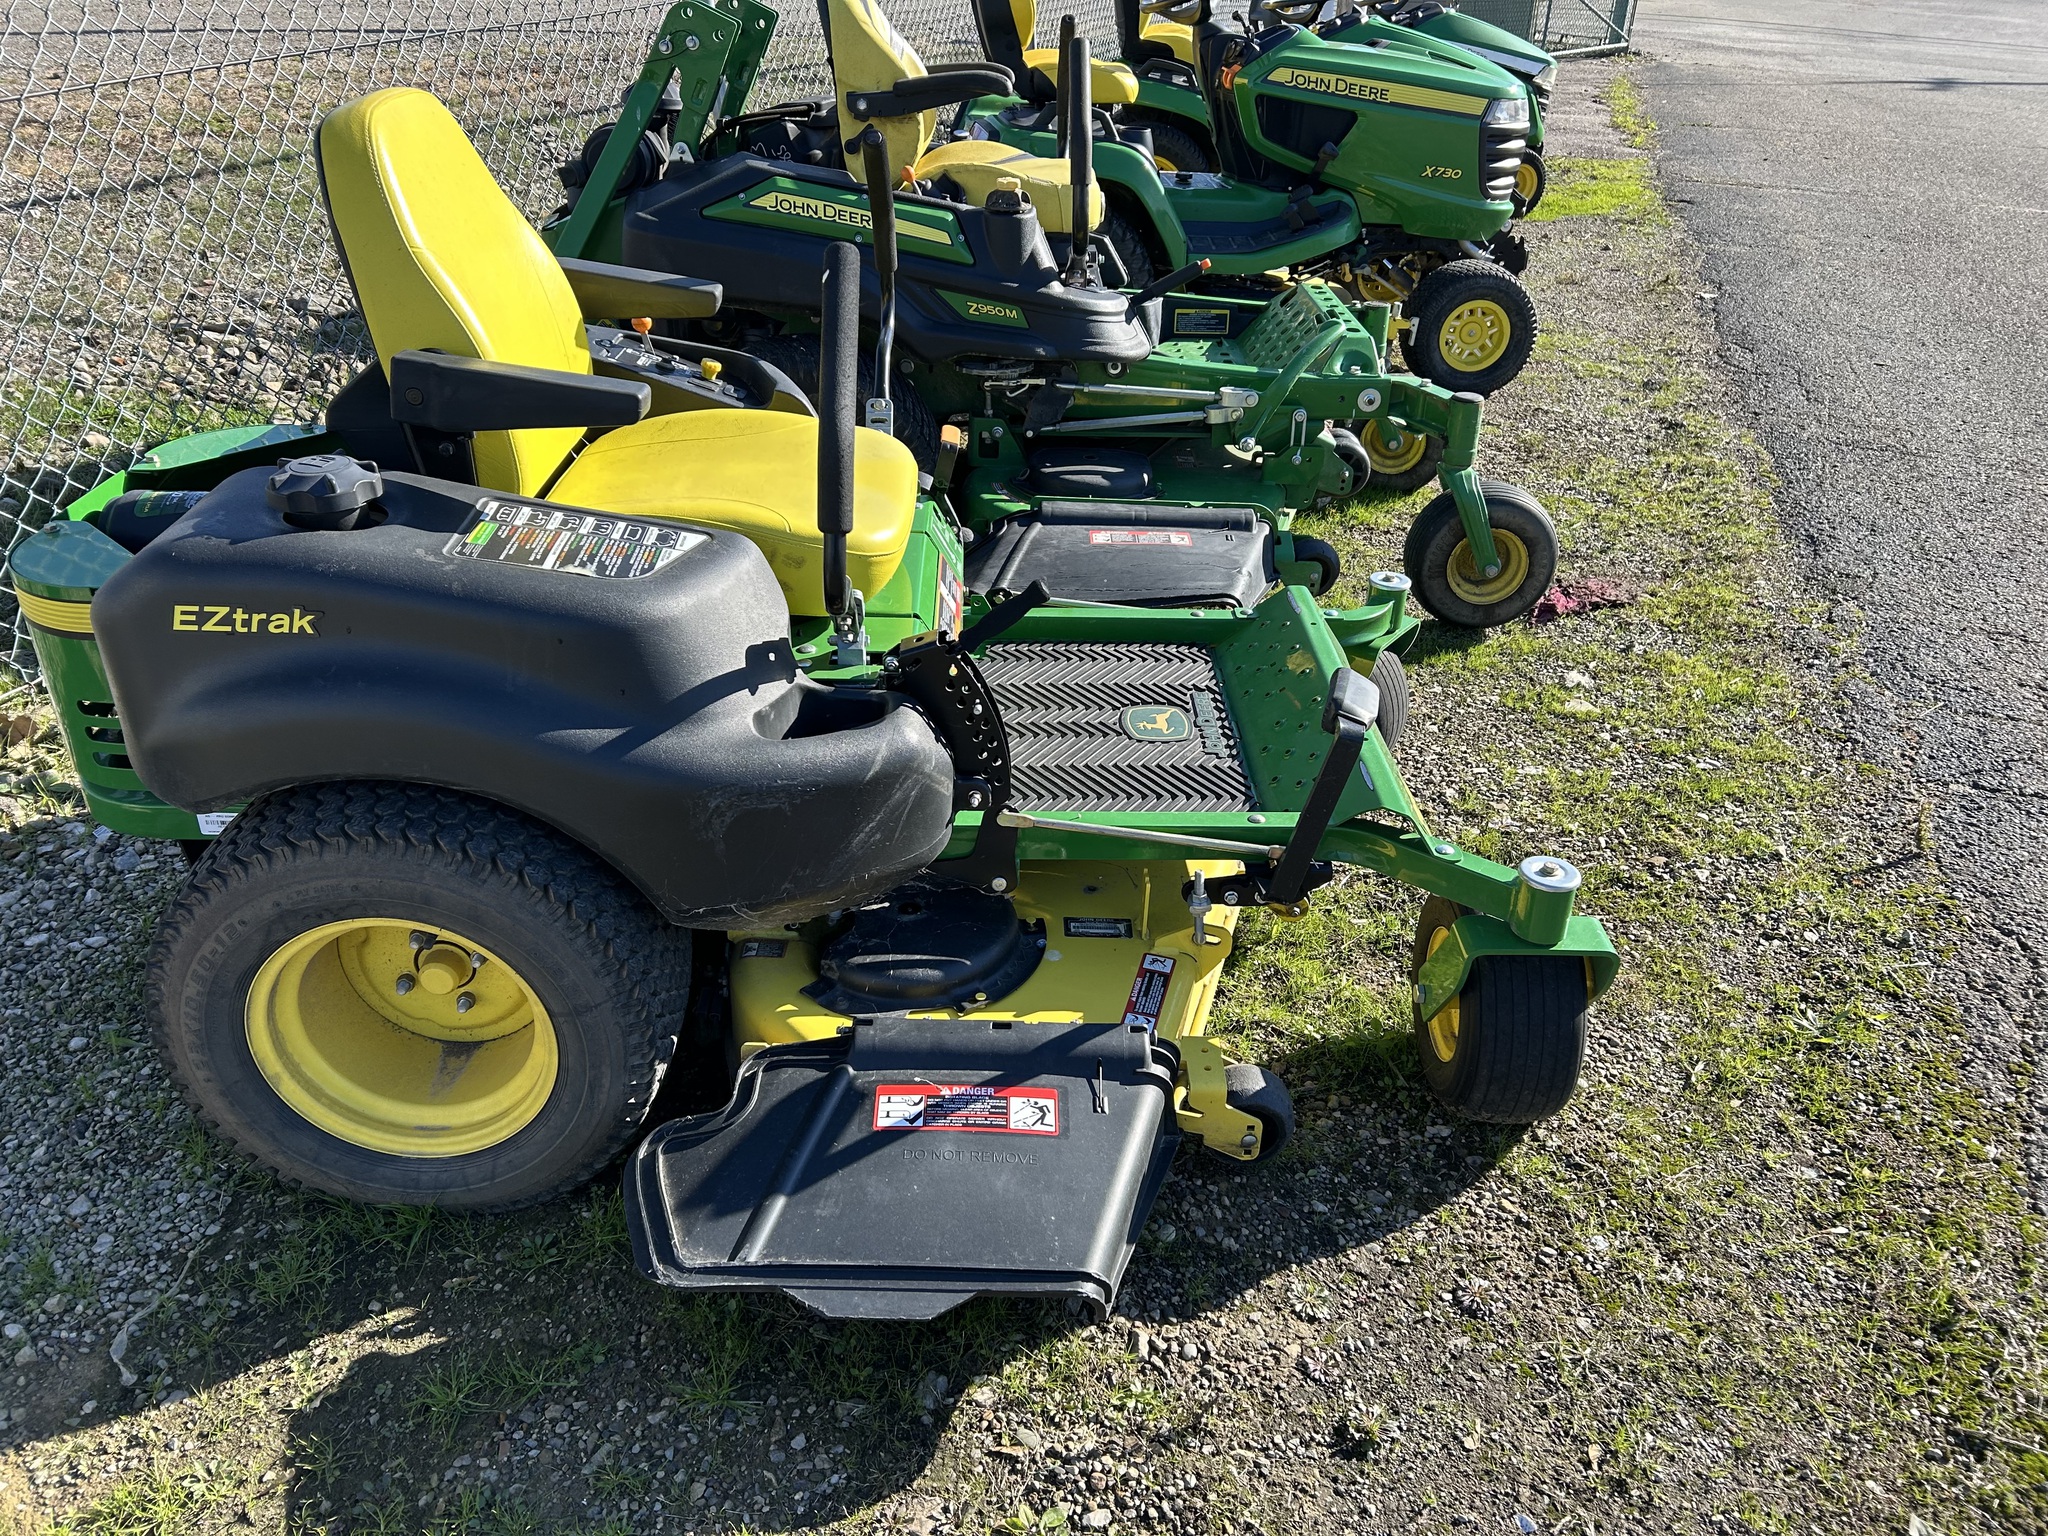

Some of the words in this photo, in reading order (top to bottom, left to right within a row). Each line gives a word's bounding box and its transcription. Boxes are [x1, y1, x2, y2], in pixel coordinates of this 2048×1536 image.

[1284, 70, 1331, 91] JOHN
[1334, 78, 1390, 101] DEERE
[1420, 165, 1462, 179] X730
[768, 194, 819, 217] JOHN
[823, 202, 872, 227] DEER
[966, 301, 1018, 319] Z950M
[172, 604, 317, 635] EZtrak
[1131, 977, 1143, 998] DANGER
[952, 1087, 995, 1096] DANGER
[902, 1148, 927, 1161] DO
[931, 1149, 965, 1162] NOT
[970, 1150, 1040, 1166] REMOVE
